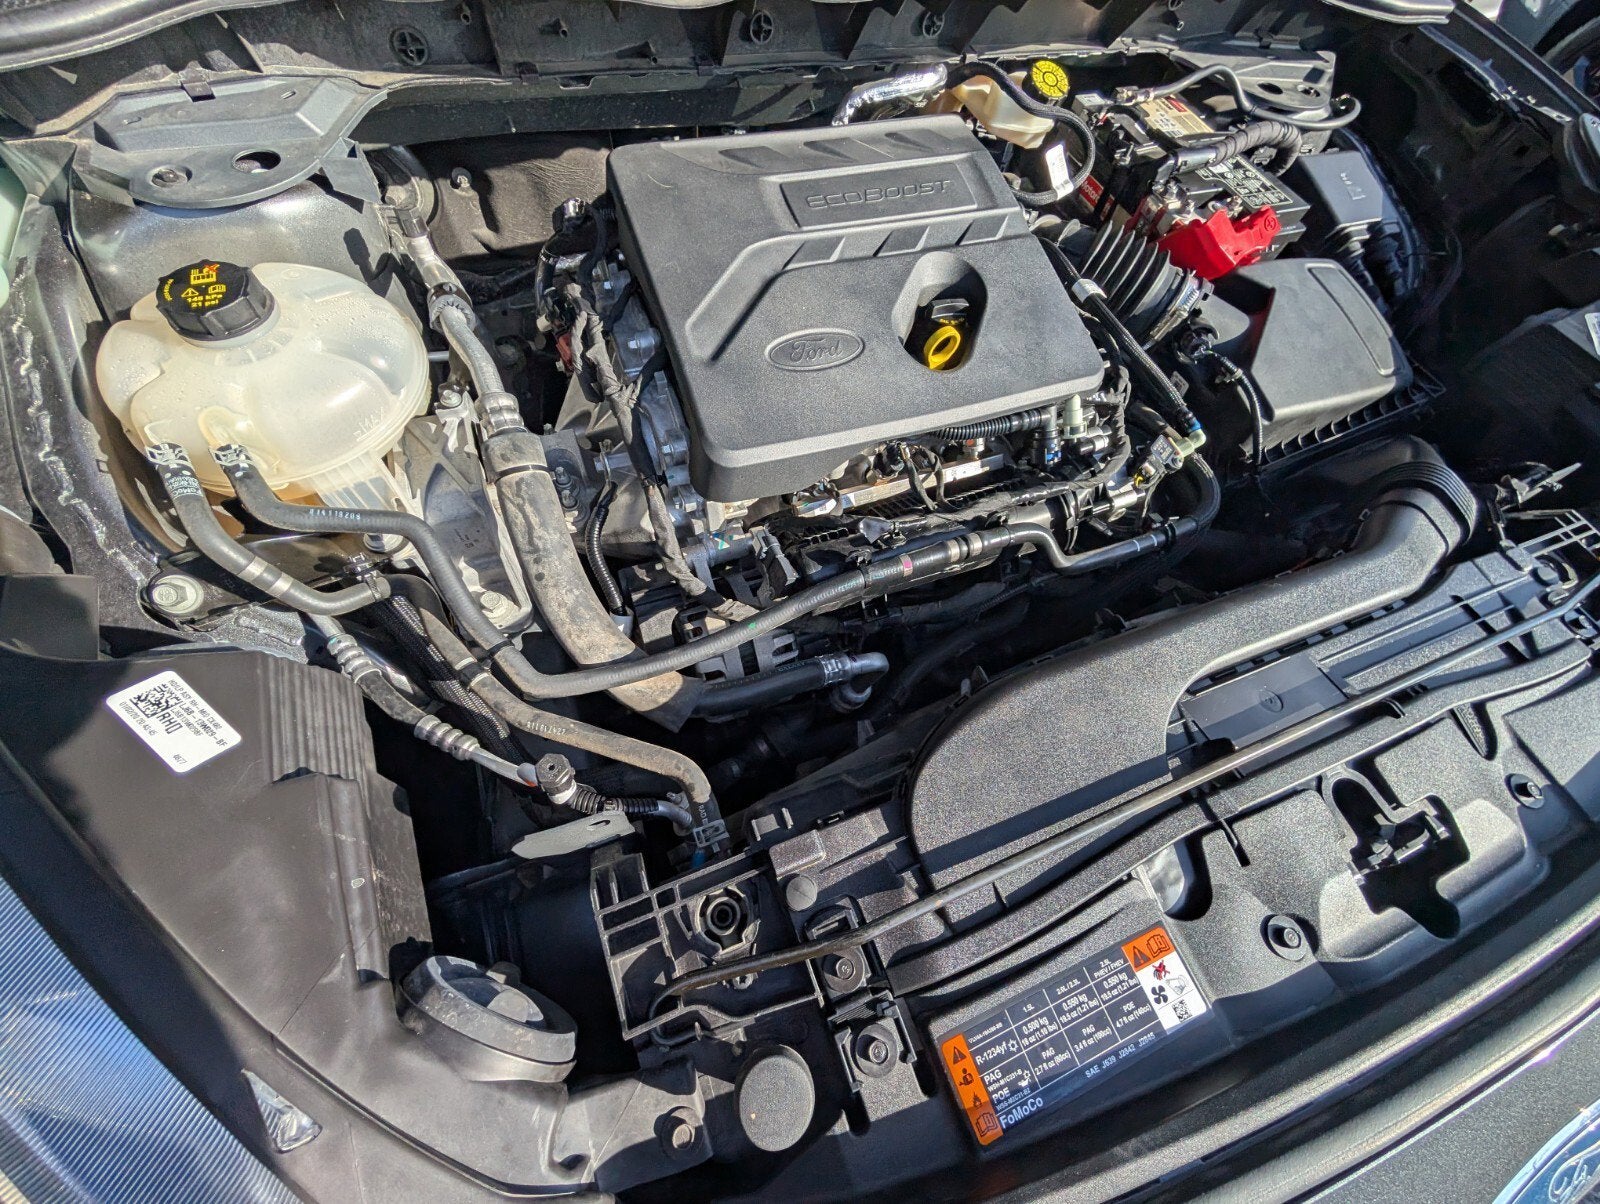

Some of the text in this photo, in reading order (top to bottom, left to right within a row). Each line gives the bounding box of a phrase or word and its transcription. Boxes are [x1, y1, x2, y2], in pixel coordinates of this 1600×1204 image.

[789, 338, 843, 363] Ford
[1118, 972, 1128, 980] kg
[1062, 994, 1088, 1010] 0.550 kg
[1123, 1001, 1135, 1012] POE
[1022, 1016, 1049, 1034] 0.500 kg
[1082, 1024, 1095, 1036] PAG
[975, 1041, 1007, 1065] R-1234yf
[1042, 1047, 1055, 1059] PAG
[1034, 1065, 1043, 1075] 2.7
[1085, 1065, 1100, 1077] SAE
[1102, 1055, 1116, 1068] J639
[984, 1069, 1001, 1084] PAG
[992, 1087, 1010, 1103] POE
[999, 1097, 1043, 1128] FoMoCo
